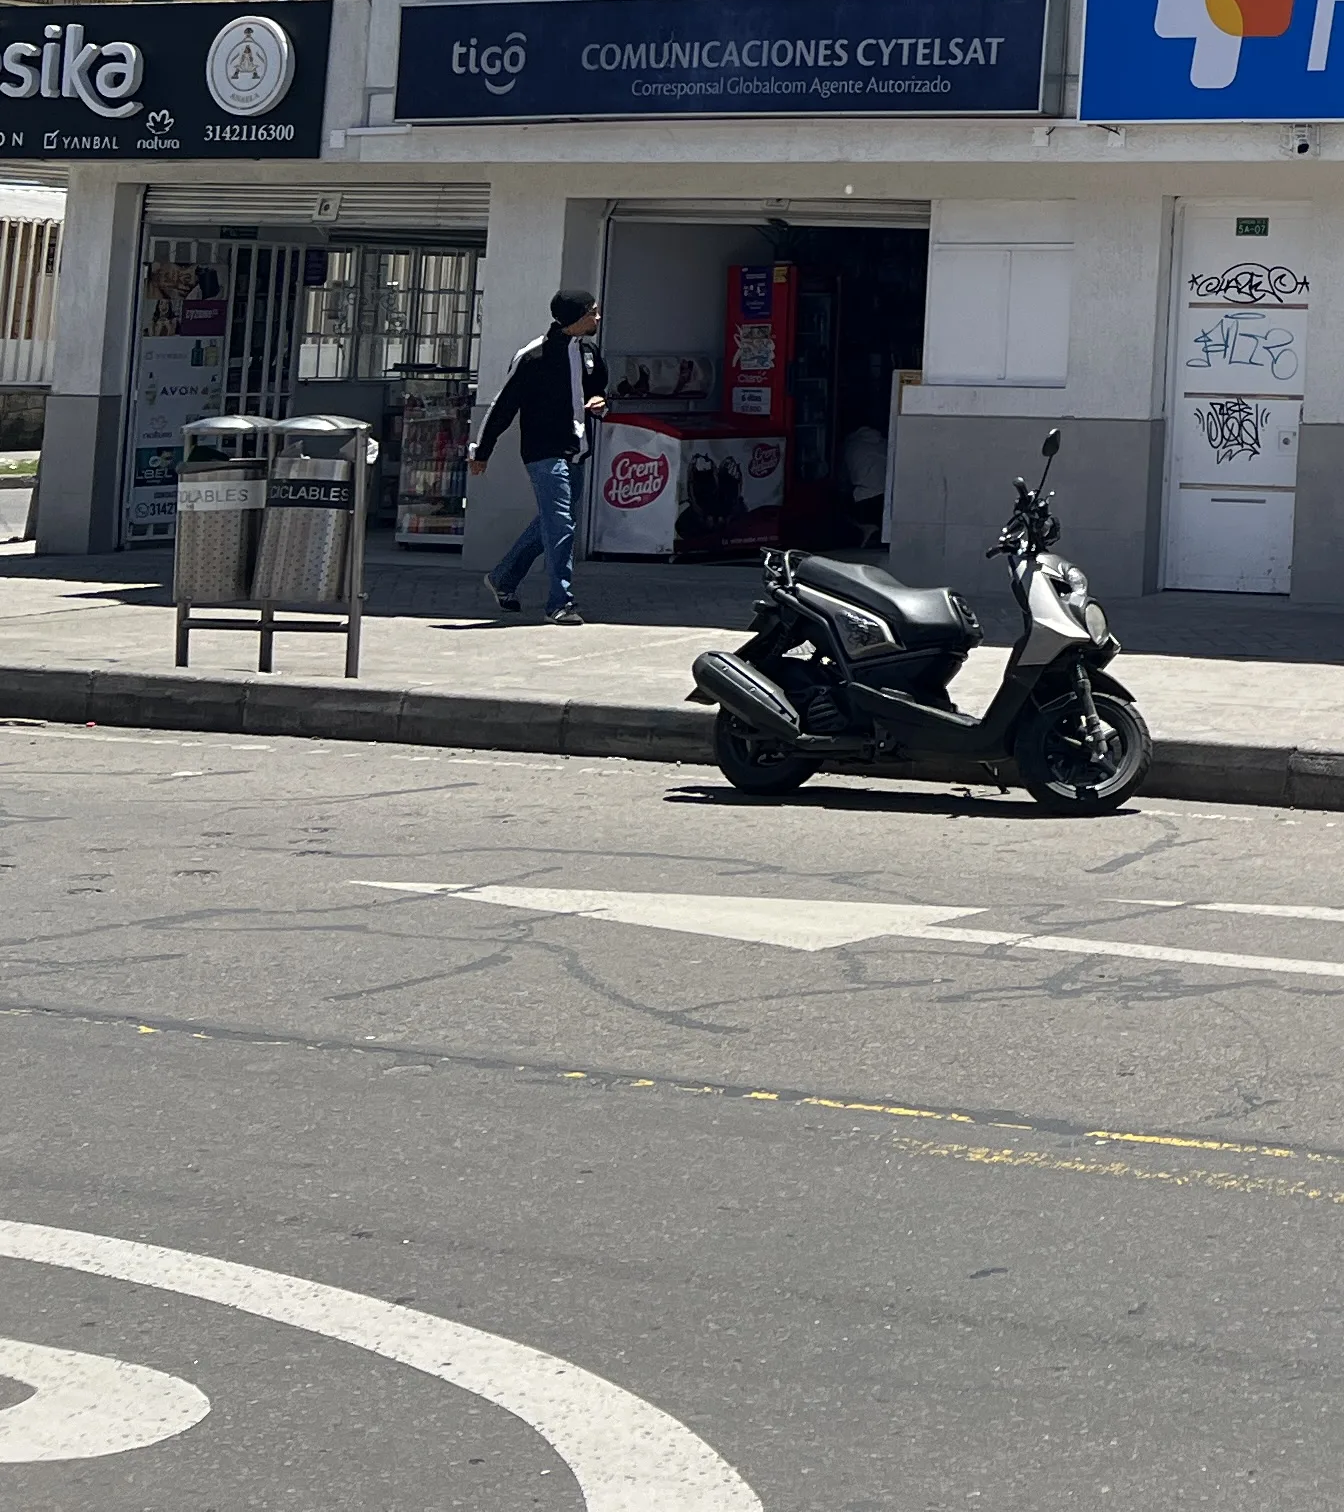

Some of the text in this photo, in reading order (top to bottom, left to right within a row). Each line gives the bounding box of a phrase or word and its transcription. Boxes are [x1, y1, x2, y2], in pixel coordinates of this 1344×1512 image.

[581, 37, 1005, 71] COMUNICACIONES CYTELSAT
[0, 23, 144, 118] sika
[631, 74, 952, 100] Corresponsal Globalcom Agente Autorizado
[62, 135, 119, 150] YANBAL
[137, 135, 181, 150] natura
[204, 124, 295, 142] 3142116300
[160, 386, 198, 396] AVON
[615, 458, 660, 481] Crem
[608, 476, 664, 505] Helado
